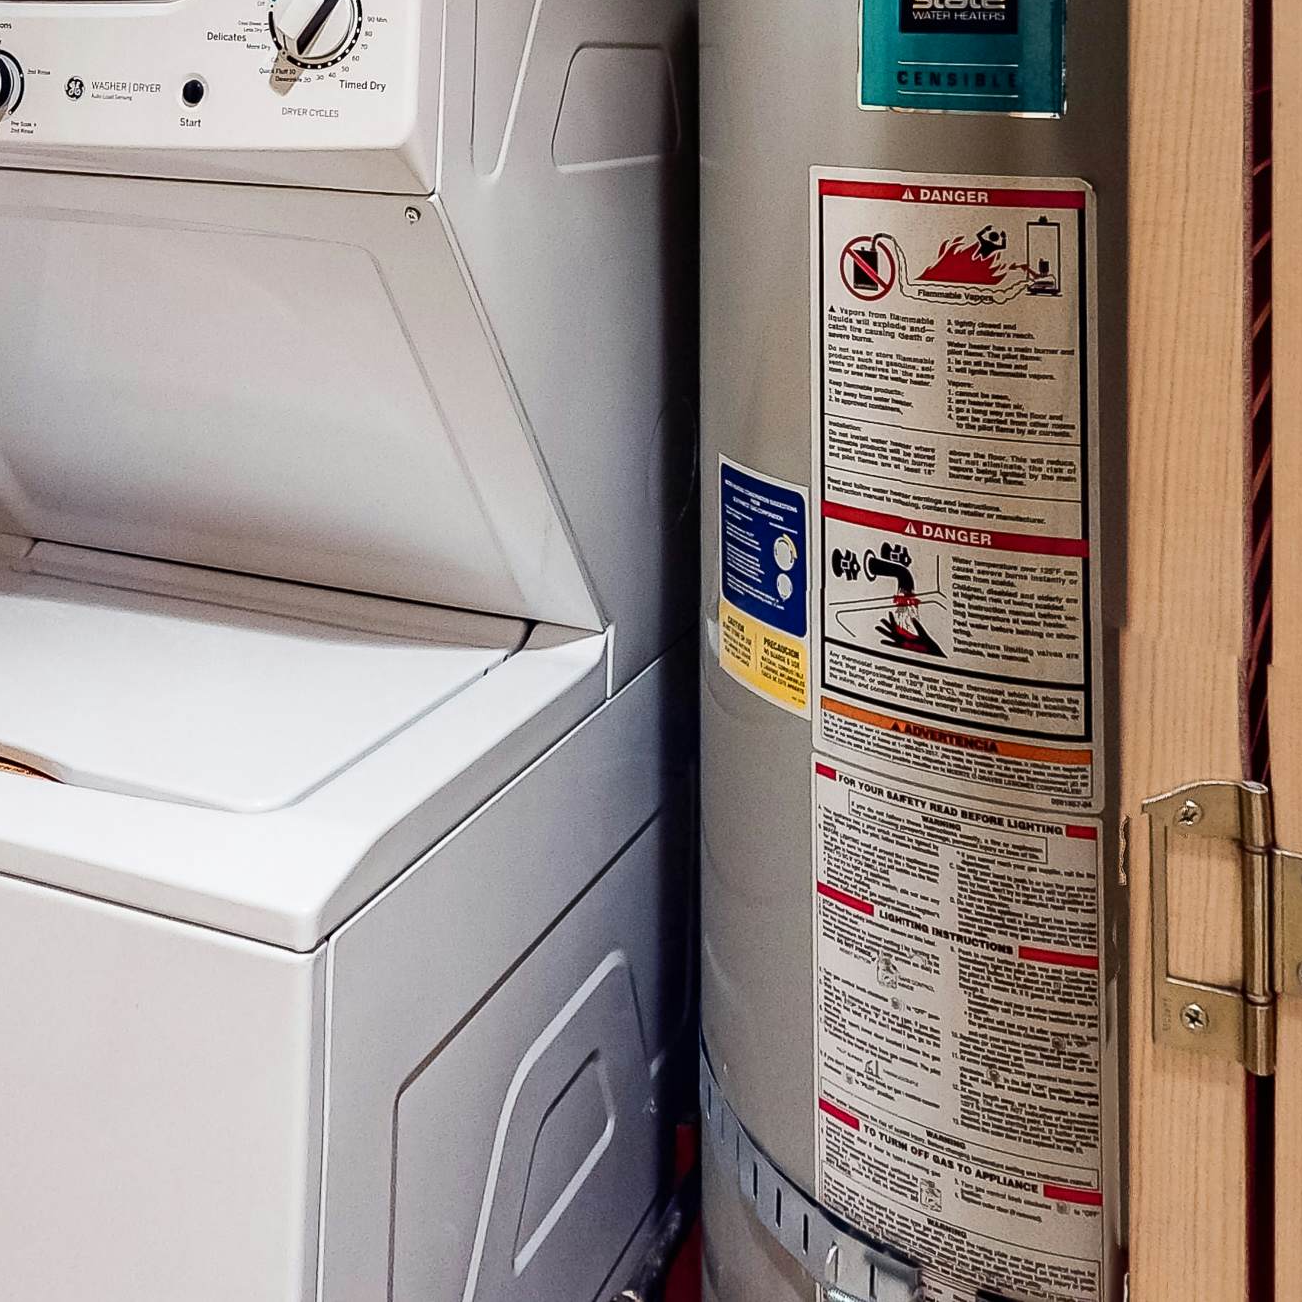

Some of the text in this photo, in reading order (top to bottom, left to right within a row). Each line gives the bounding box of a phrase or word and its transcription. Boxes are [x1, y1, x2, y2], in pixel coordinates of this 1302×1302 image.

[912, 10, 1006, 21] WATER HEATERS
[206, 31, 247, 42] Delicates
[339, 79, 387, 93] Timed Dry
[898, 70, 1018, 88] CENSIBLE
[91, 81, 162, 93] WASHER DRYER
[281, 107, 339, 118] DRYER CYCLES
[179, 117, 202, 128] Start
[919, 188, 989, 204] DANGER
[918, 289, 994, 302] Flammable Vapors
[869, 311, 886, 319] from
[922, 524, 991, 546] DANGER
[905, 721, 998, 752] ADVERTENCIA
[838, 775, 856, 788] FOR
[858, 782, 884, 797] YOUR
[887, 791, 926, 809] SAFETY
[929, 803, 958, 817] READ
[961, 810, 1004, 827] BEFORE
[1007, 819, 1064, 835] LIGHTING
[879, 910, 1013, 955] LIGHTING INSTRUCTIONS
[864, 1124, 1039, 1194] TO TURN OFF GAS TO APPLIANCE
